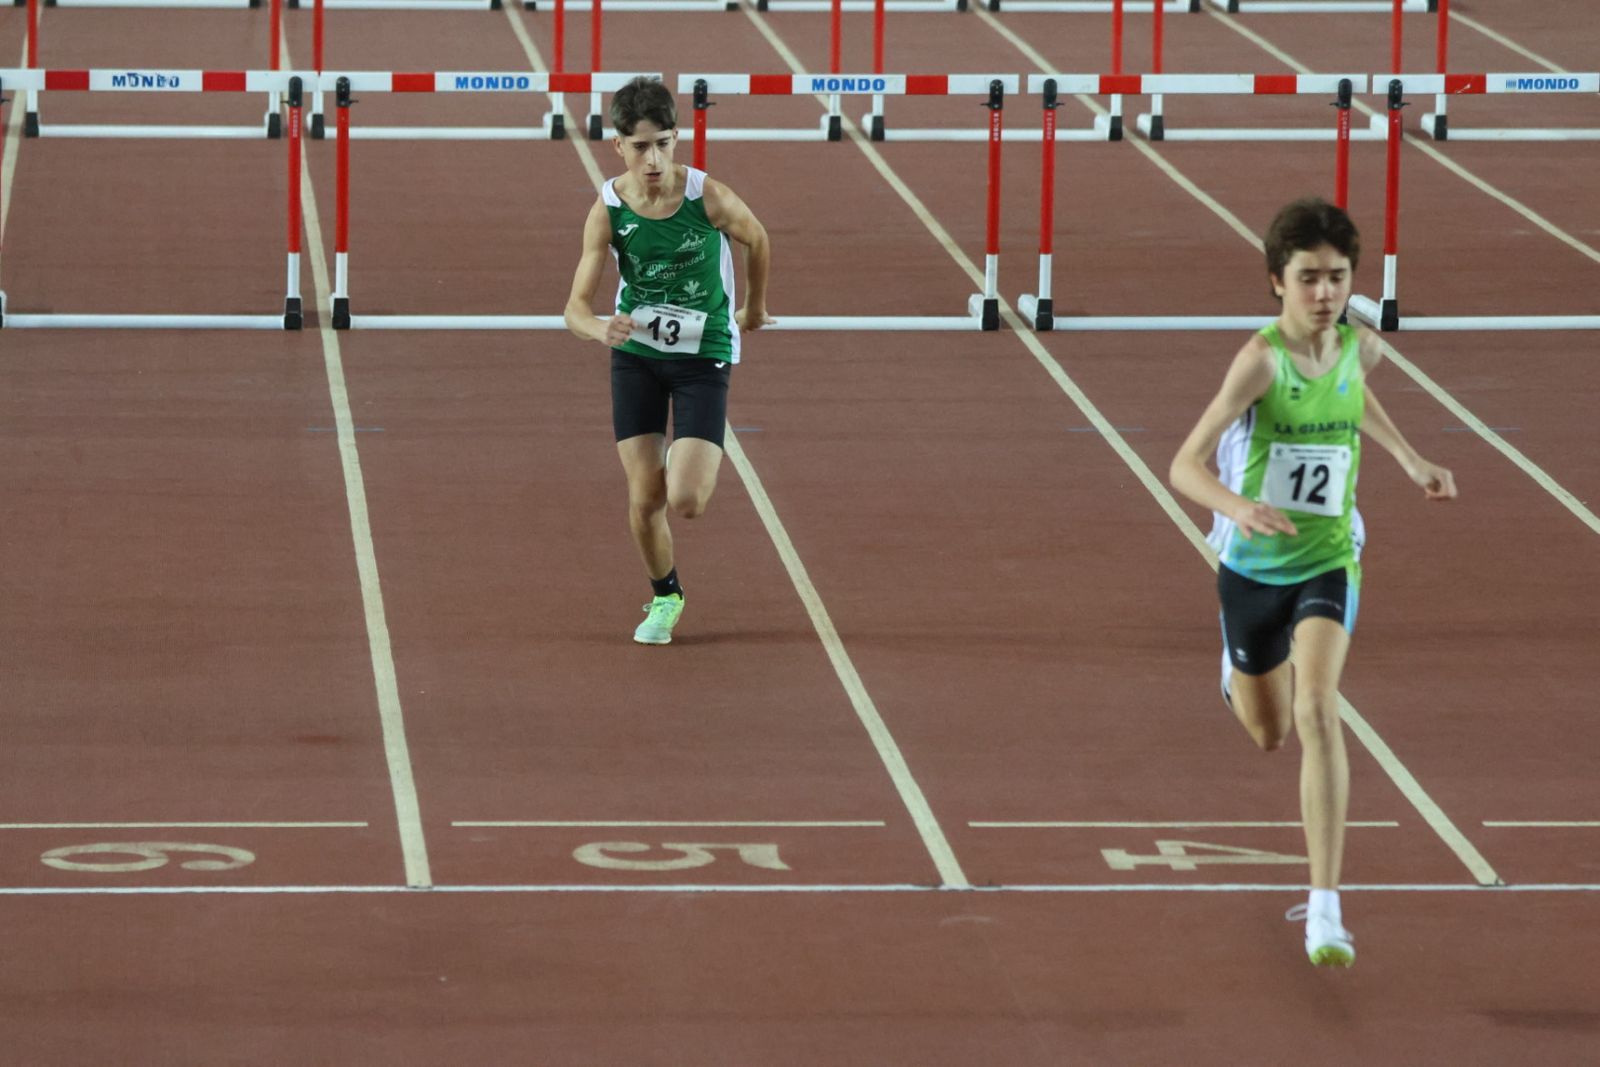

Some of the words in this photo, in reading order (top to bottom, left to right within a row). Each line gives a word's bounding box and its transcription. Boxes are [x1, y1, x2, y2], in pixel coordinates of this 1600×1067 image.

[455, 76, 529, 89] MONDO
[812, 78, 885, 91] MONDO
[1518, 78, 1579, 90] MONDO
[647, 316, 681, 346] 13
[1289, 463, 1330, 506] 12
[40, 841, 256, 872] 6
[572, 841, 792, 871] 5
[1100, 839, 1309, 870] 4
